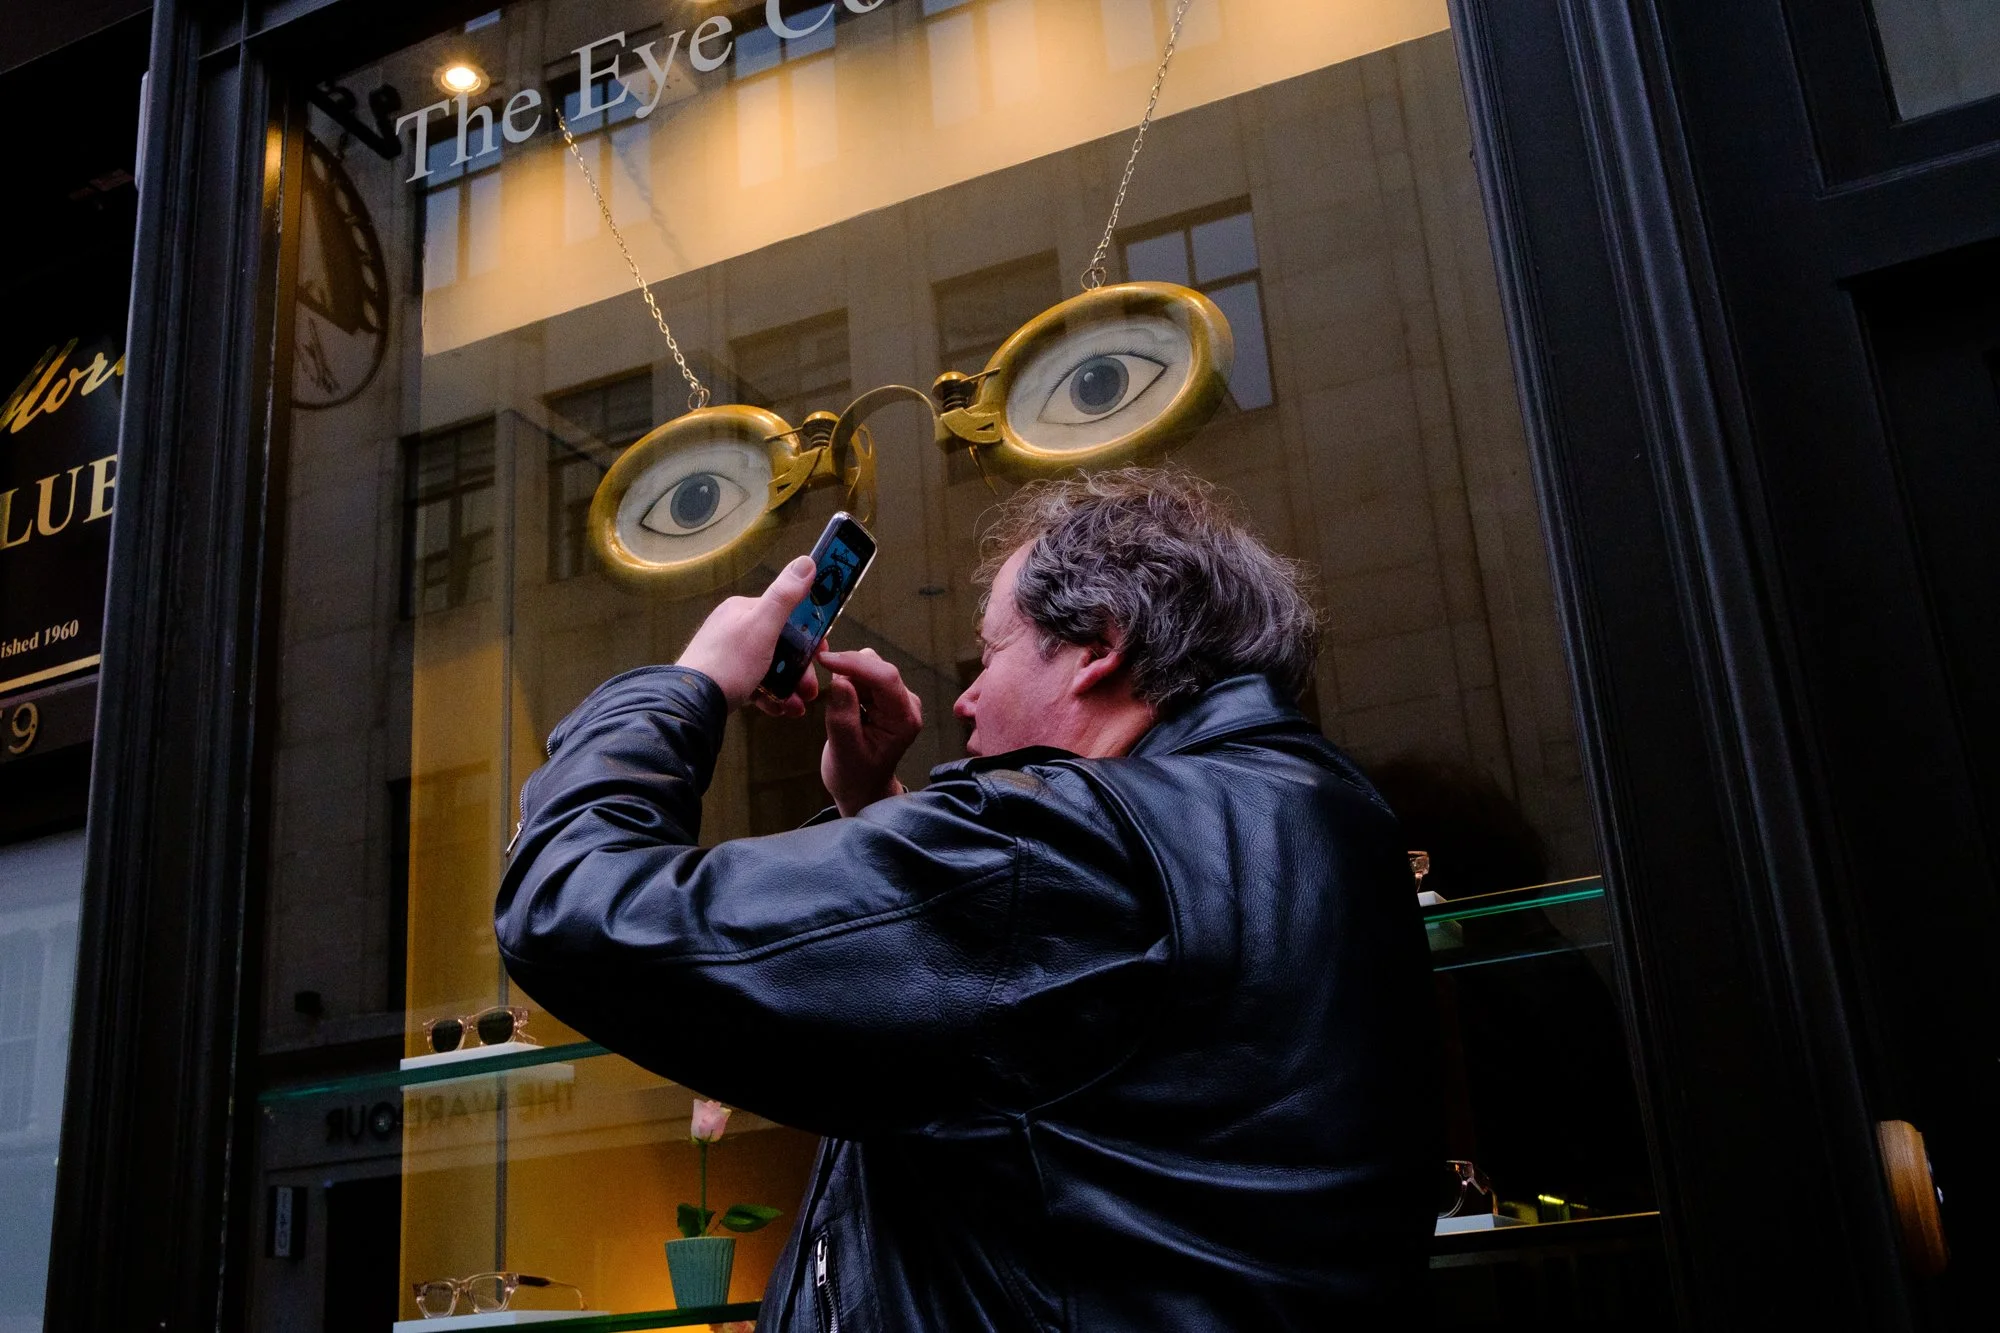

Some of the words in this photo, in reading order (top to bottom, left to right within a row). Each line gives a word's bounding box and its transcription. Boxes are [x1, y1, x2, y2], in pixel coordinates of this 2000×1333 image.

[396, 89, 541, 183] The
[570, 14, 732, 122] Eye
[44, 619, 80, 646] 1960
[0, 702, 39, 755] 9
